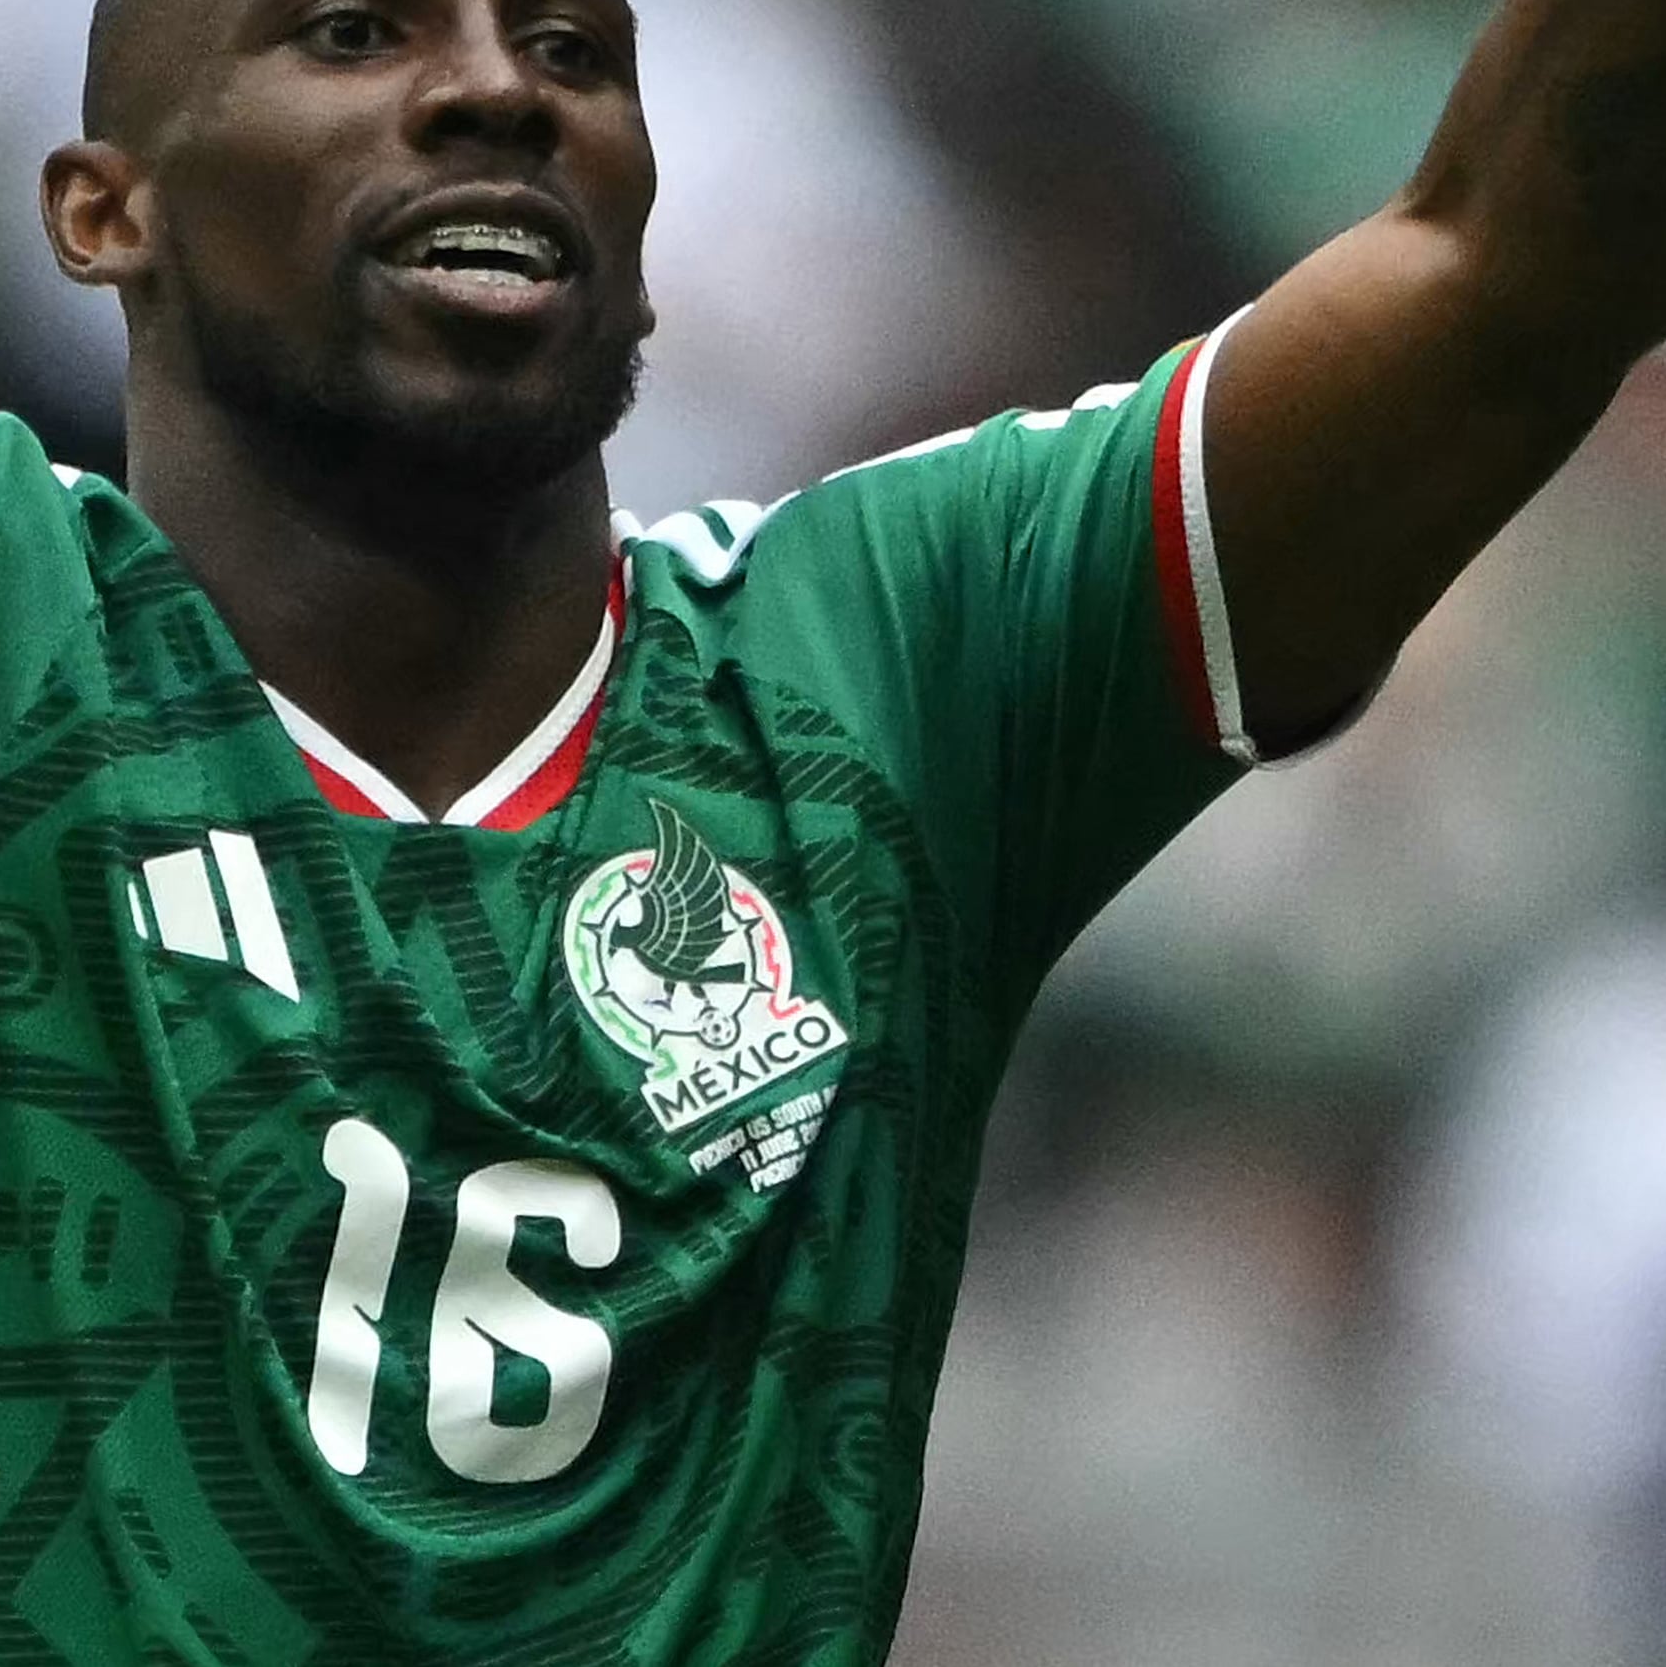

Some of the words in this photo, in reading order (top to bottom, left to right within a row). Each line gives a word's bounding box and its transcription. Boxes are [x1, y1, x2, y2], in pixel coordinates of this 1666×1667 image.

[651, 1016, 832, 1125] MÉXICO
[770, 1091, 824, 1129] SOUTH
[750, 1151, 807, 1193] MEXIC
[307, 1116, 622, 1483] 16
